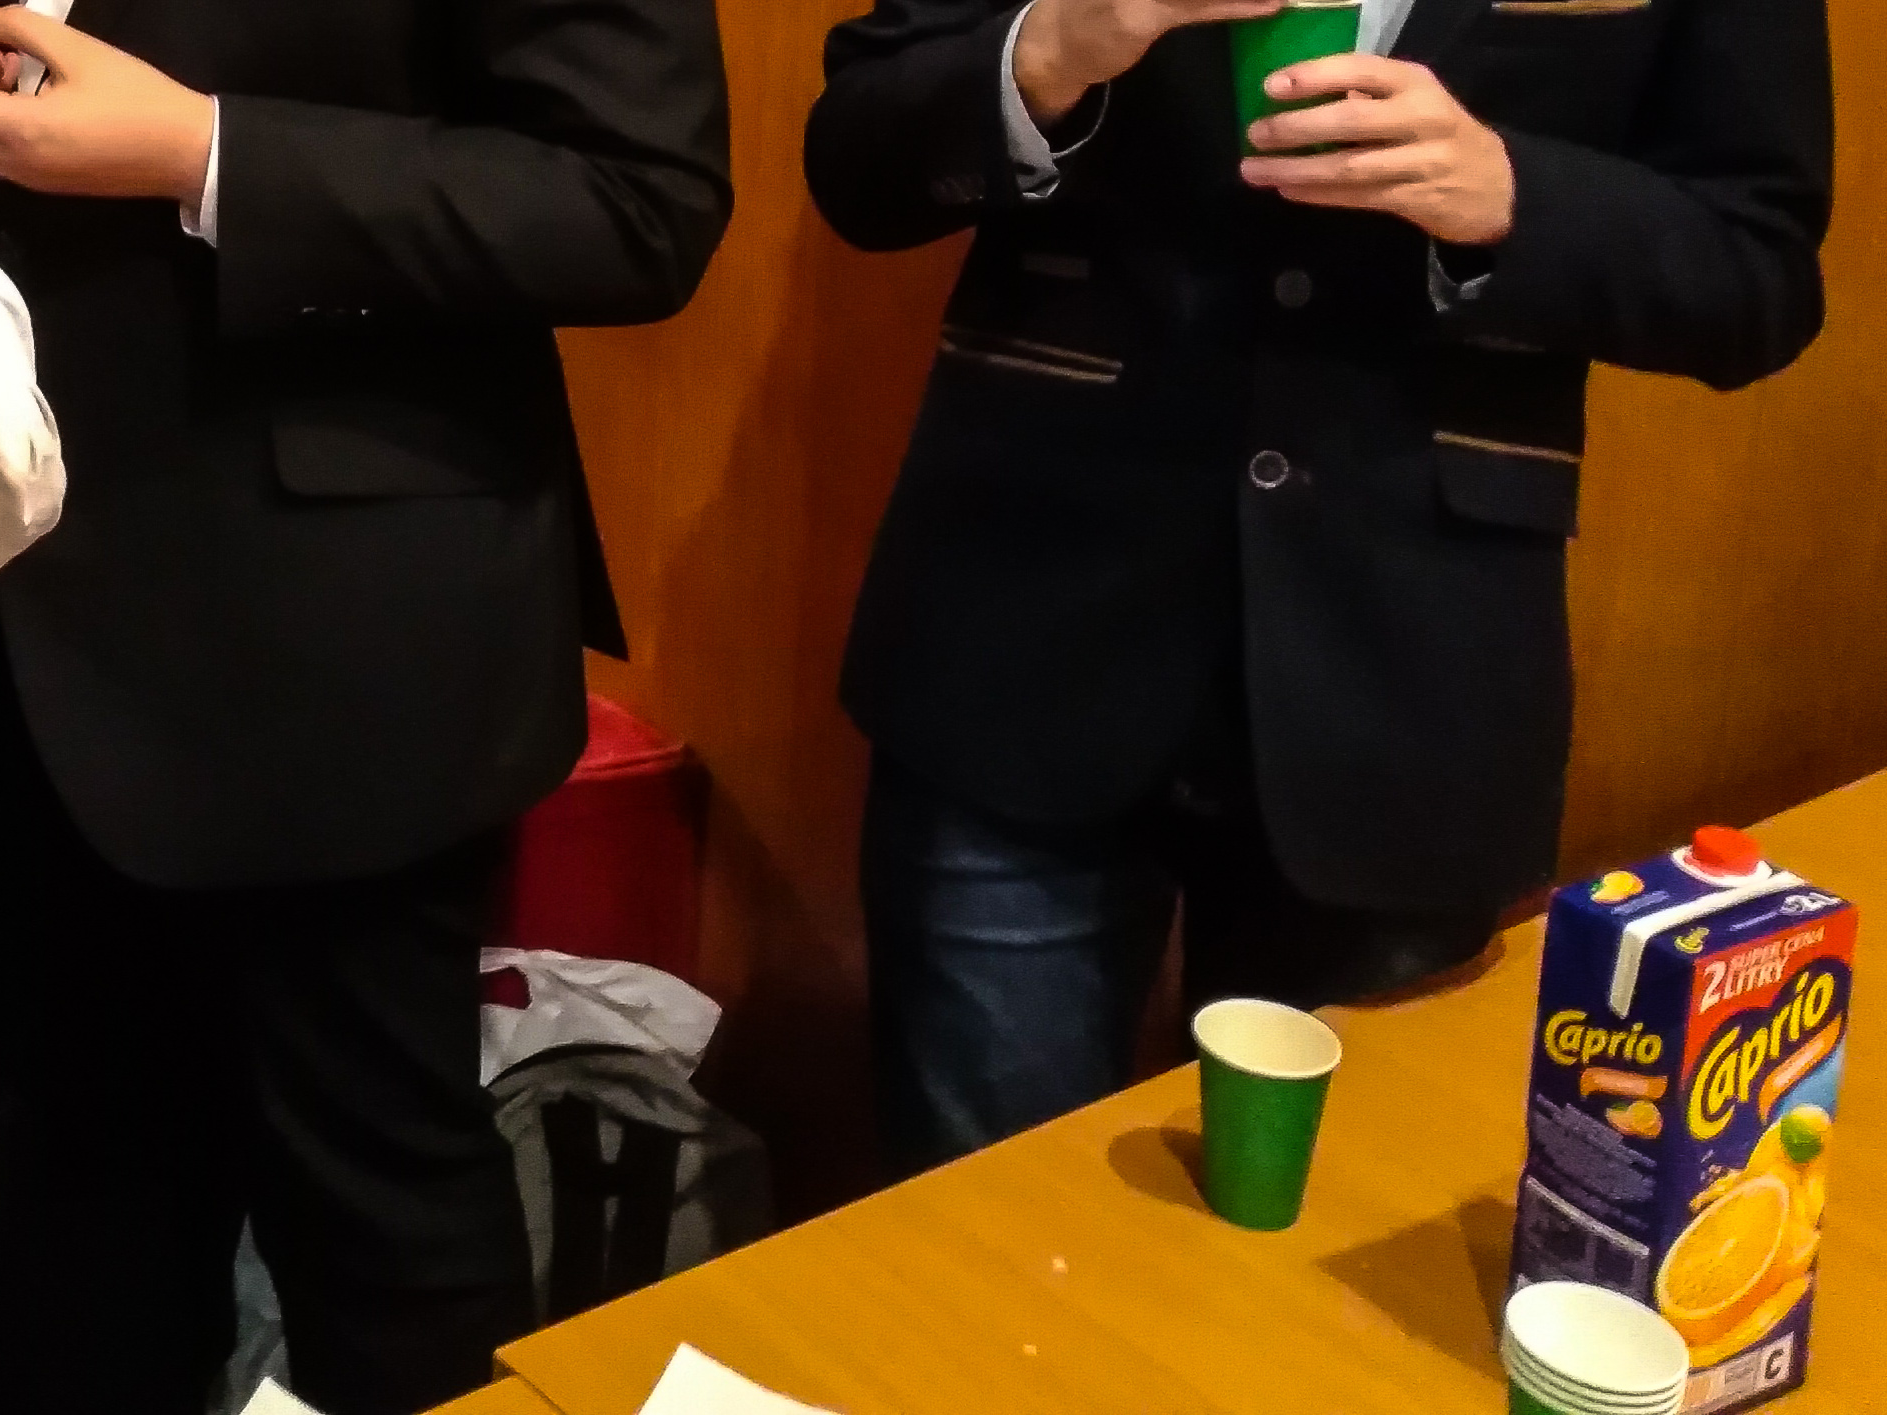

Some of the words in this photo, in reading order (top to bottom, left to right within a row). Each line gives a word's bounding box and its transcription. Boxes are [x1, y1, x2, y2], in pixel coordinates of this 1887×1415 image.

[1723, 950, 1791, 1000] LITRY
[1544, 1010, 1662, 1066] Caprio
[1686, 970, 1835, 1141] Caprio
